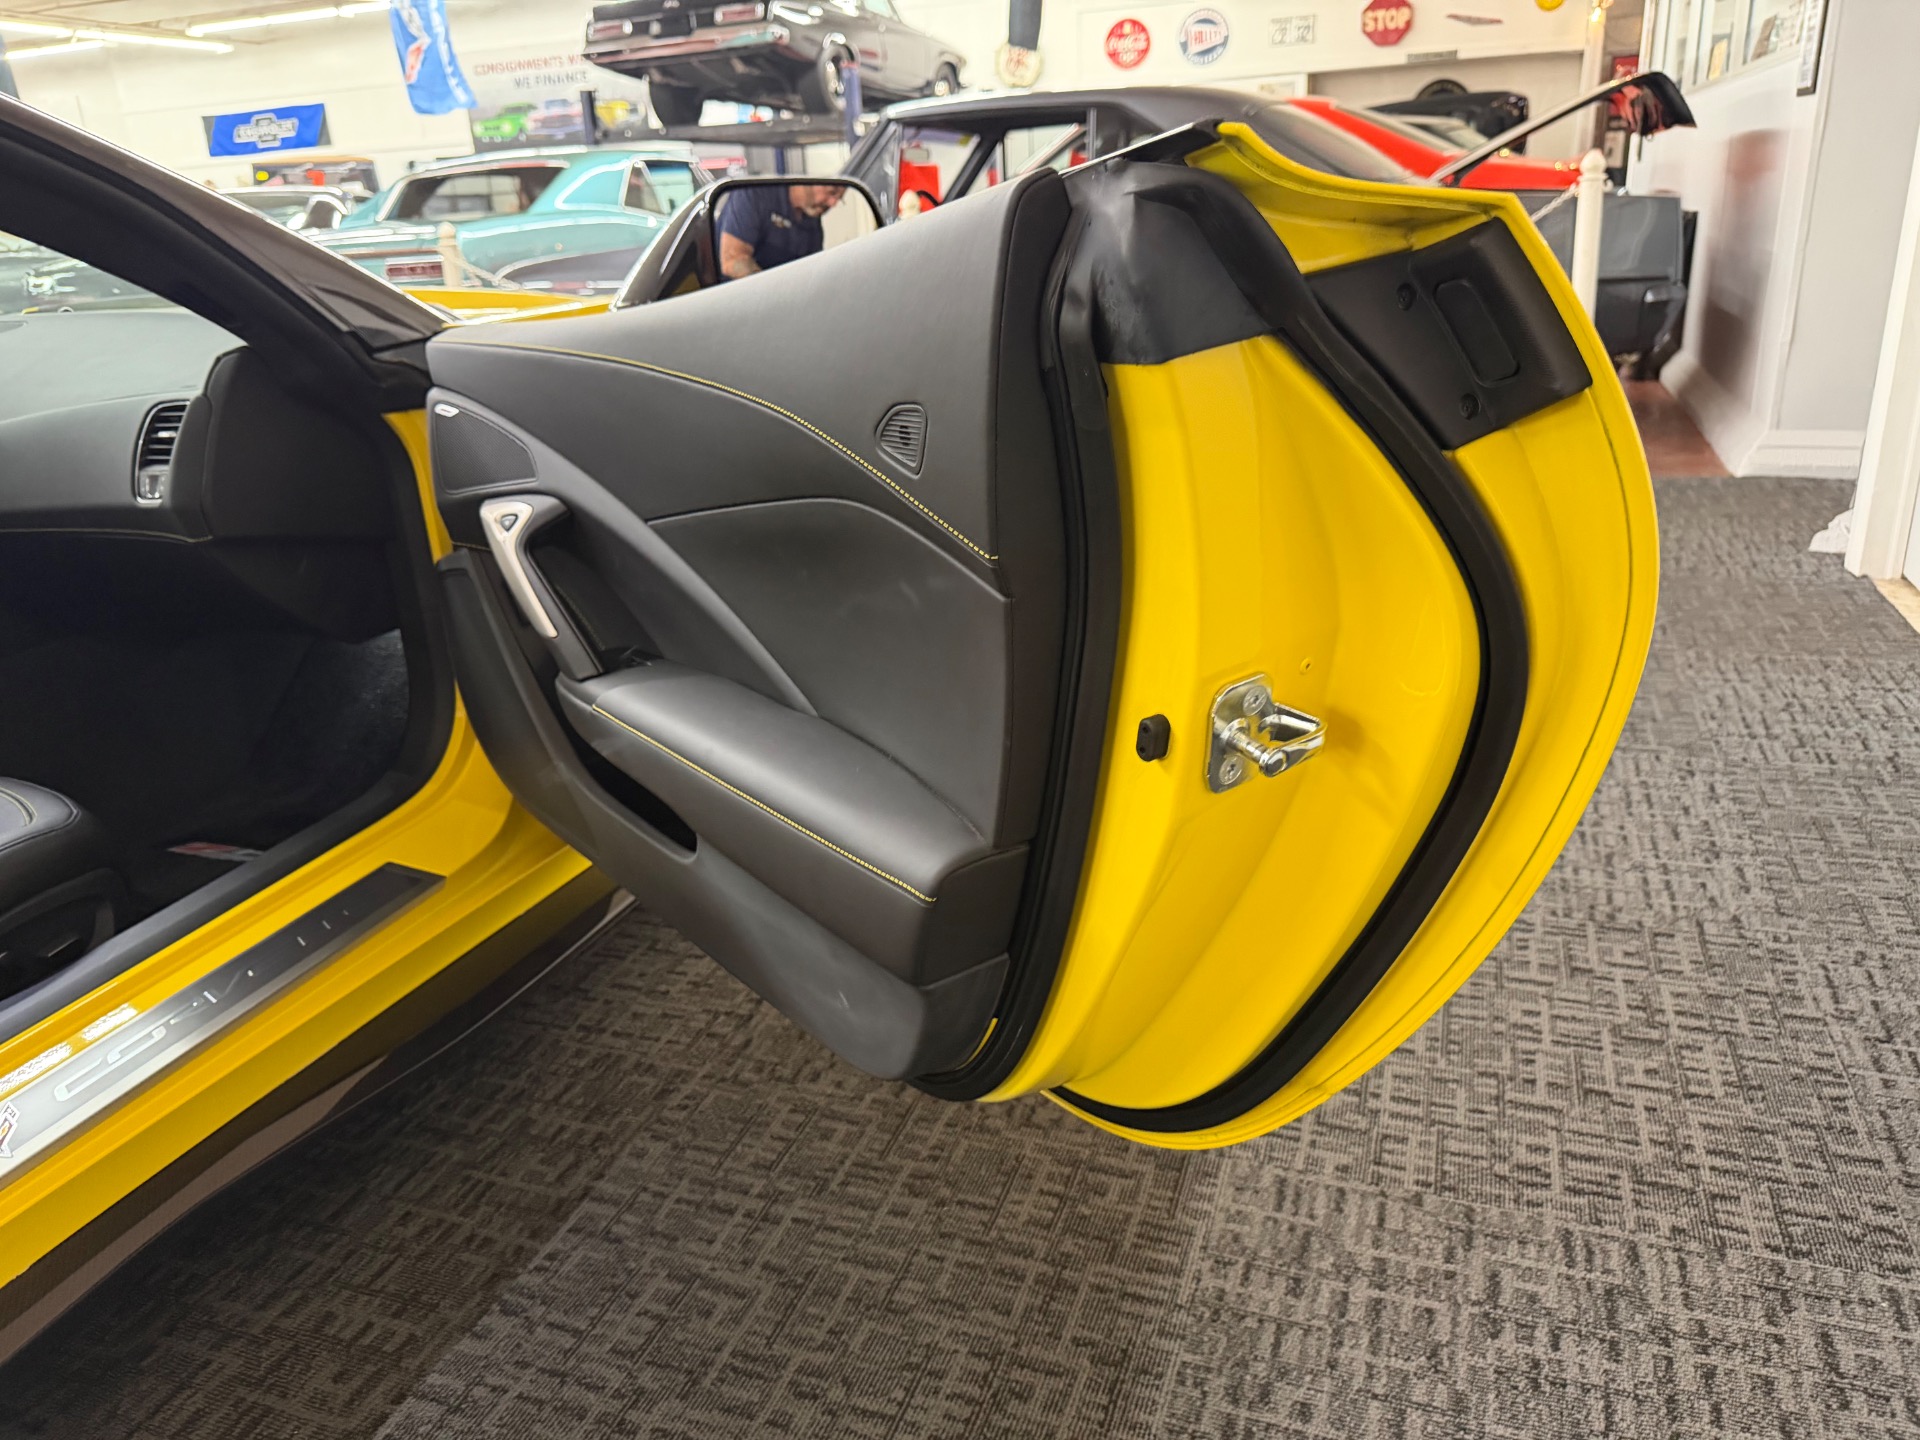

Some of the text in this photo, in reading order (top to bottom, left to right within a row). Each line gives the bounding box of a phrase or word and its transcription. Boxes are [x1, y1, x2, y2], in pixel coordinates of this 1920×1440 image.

[1364, 6, 1411, 33] STOP
[474, 55, 563, 75] CONSIGNMENTS
[513, 70, 587, 89] WE FINANCE
